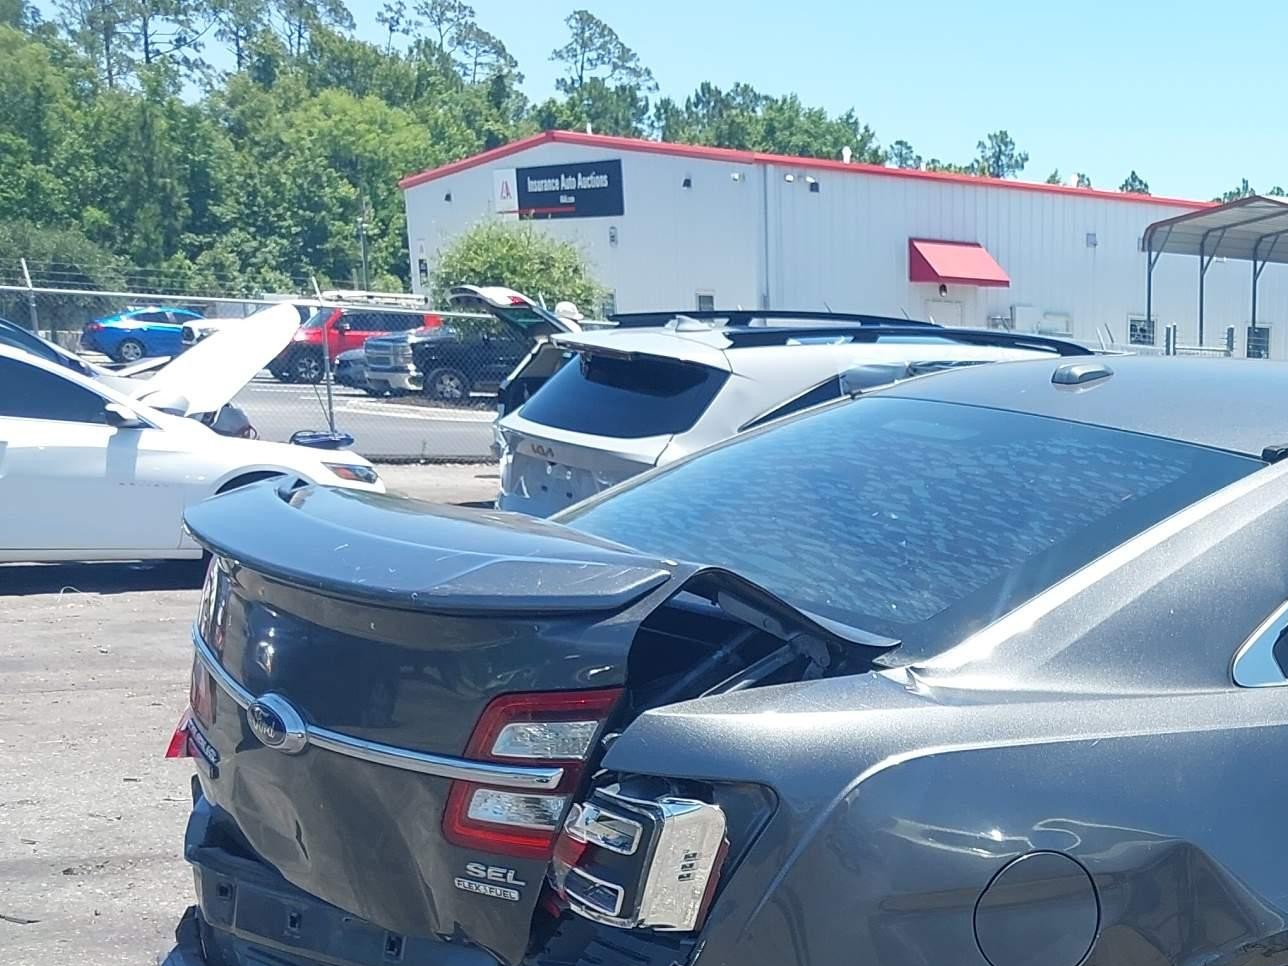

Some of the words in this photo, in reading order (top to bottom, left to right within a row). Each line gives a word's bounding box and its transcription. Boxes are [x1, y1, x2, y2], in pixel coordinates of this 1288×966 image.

[527, 176, 559, 192] Insurance
[561, 174, 577, 190] Auto
[577, 171, 608, 189] Auctions
[251, 706, 277, 739] Ford
[465, 862, 526, 886] SEL
[456, 879, 480, 893] FLEX
[488, 887, 518, 900] FUEL
